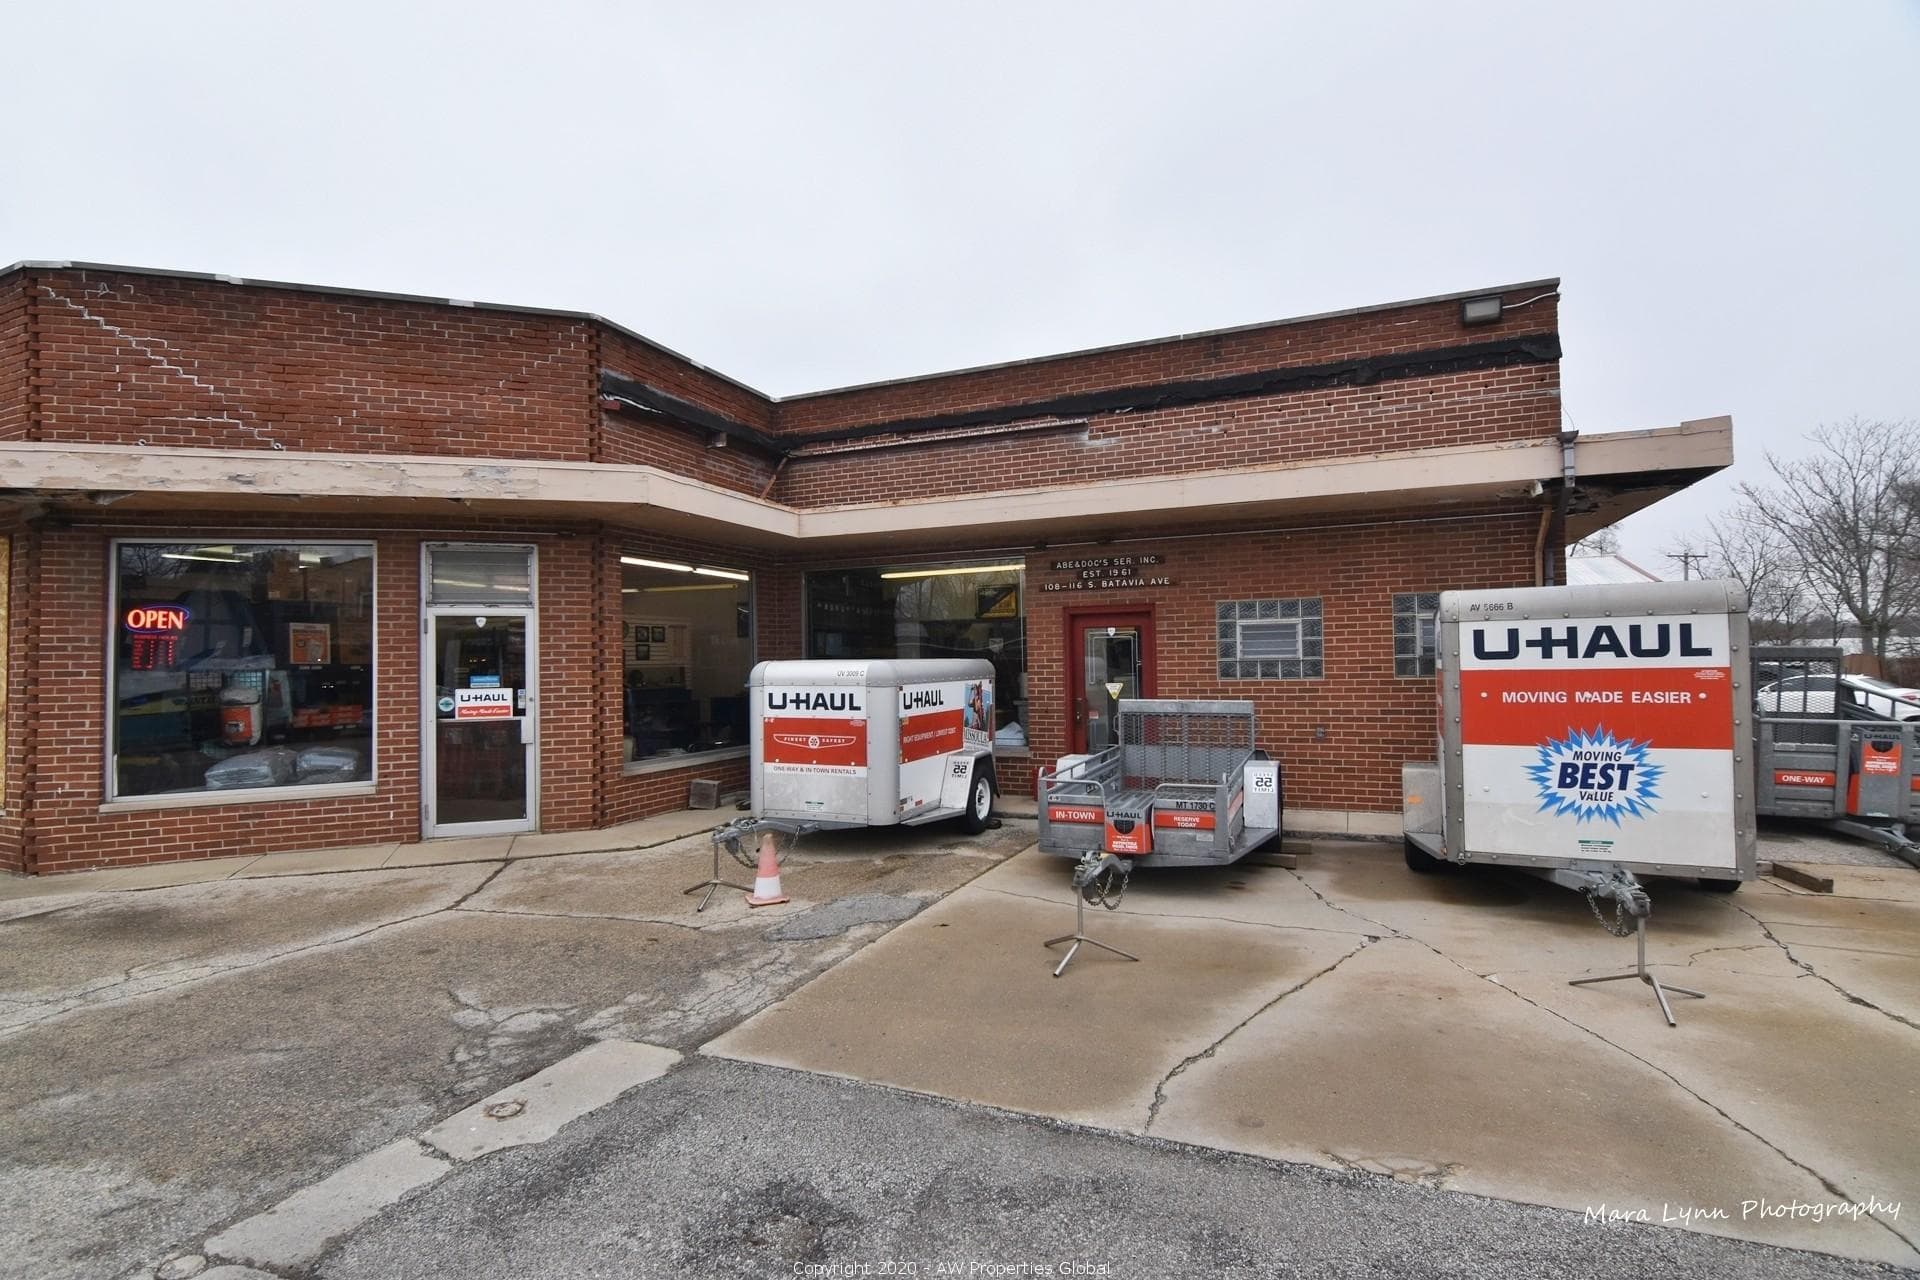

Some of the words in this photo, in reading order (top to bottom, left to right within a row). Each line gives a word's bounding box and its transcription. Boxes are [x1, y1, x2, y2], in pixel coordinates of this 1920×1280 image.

[1056, 559, 1109, 569] ABE&DOC'S
[1044, 582, 1083, 591] 108-116
[1088, 581, 1097, 589] S.
[1101, 578, 1145, 588] BATAVIA
[1150, 577, 1170, 586] AVE
[1470, 604, 1481, 612] AV
[1507, 602, 1514, 611] B
[127, 609, 184, 630] OPEN
[1473, 623, 1713, 660] U-HAUL
[460, 694, 508, 702] U-HAUL
[768, 692, 862, 711] U-HAUL
[903, 689, 944, 710] U-HAUL
[1502, 691, 1568, 704] MOVING
[1575, 691, 1623, 704] MADE
[1631, 691, 1692, 705] EASIER
[1572, 751, 1622, 762] MOVING
[1557, 762, 1635, 791] BEST
[1782, 775, 1826, 783] ONE-WAY
[1580, 791, 1614, 802] VALUE
[1175, 802, 1187, 810] MT
[1190, 802, 1208, 810] 1730
[1055, 811, 1096, 820] IN-TOWN
[1106, 811, 1142, 819] U-HAUL
